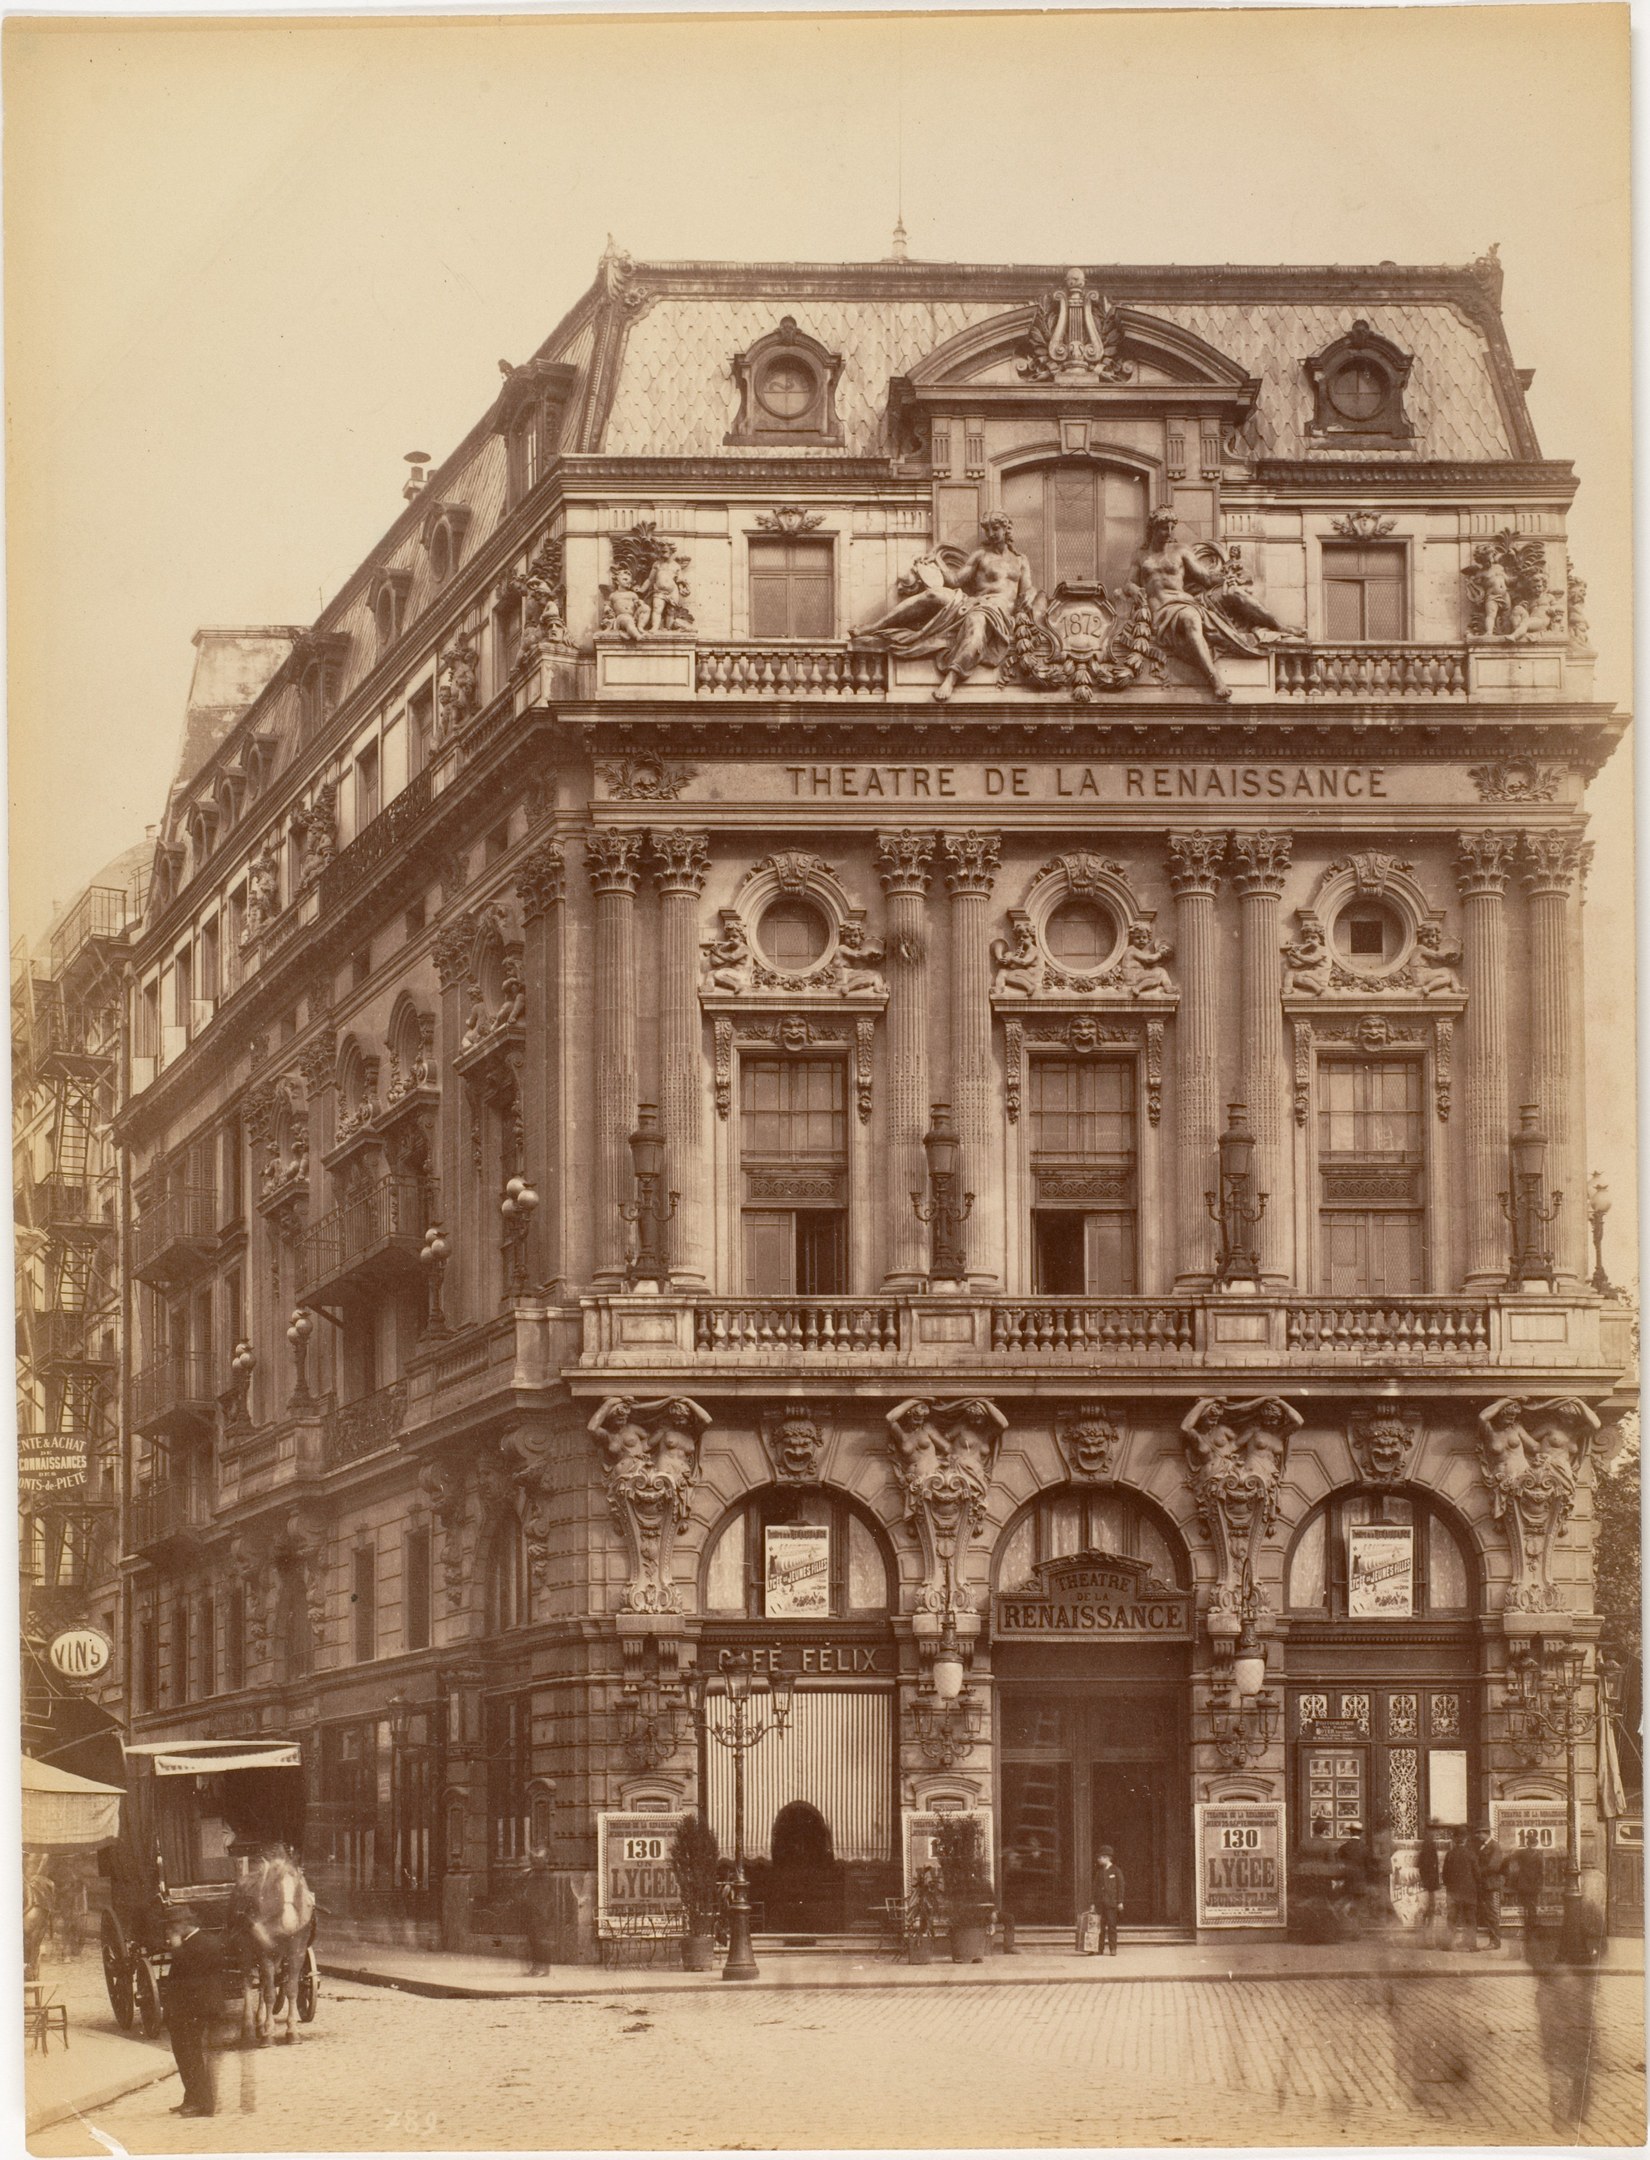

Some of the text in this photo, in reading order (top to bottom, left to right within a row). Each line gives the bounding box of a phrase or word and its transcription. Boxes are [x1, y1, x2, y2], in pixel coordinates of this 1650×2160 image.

[1060, 613, 1101, 639] 1872
[786, 767, 1387, 798] THEATRE DE LA RENAISSANCE
[51, 1436, 87, 1453] ACHAT
[18, 1455, 87, 1471] CONNAISSANCES
[1056, 1572, 1132, 1593] THEATRE
[1077, 1593, 1109, 1601] DE LA
[1004, 1604, 1182, 1629] RENAISSANCE
[55, 1641, 100, 1670] VINS
[1223, 1829, 1258, 1848] 130
[627, 1840, 661, 1858] 130
